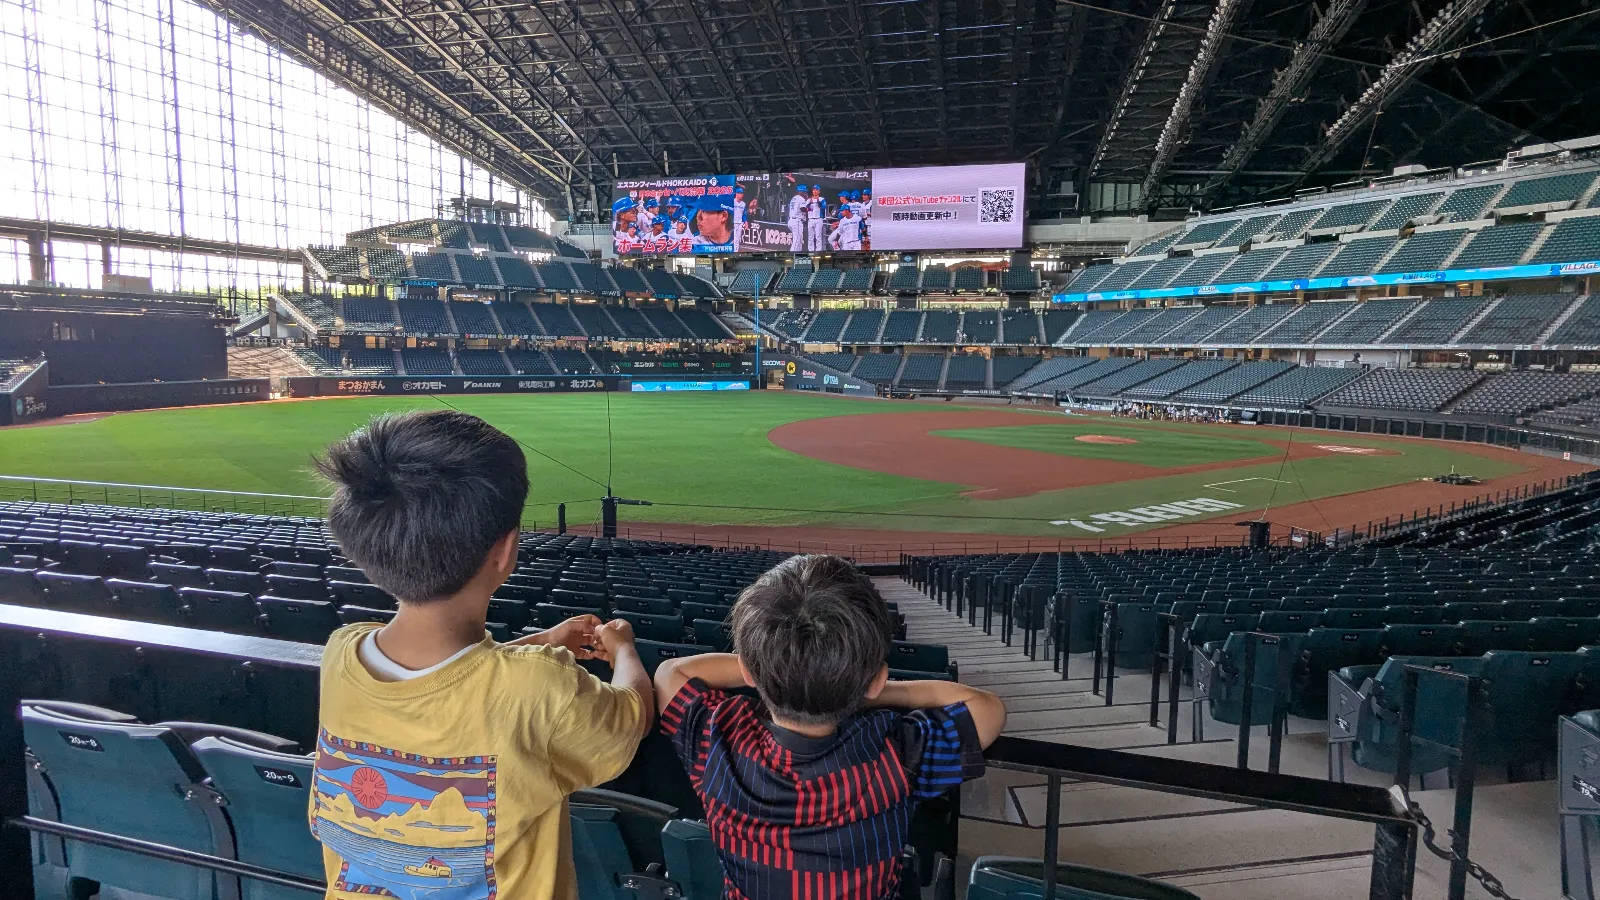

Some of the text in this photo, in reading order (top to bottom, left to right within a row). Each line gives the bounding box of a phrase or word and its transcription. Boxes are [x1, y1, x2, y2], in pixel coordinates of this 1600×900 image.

[617, 238, 693, 253] ホームラン集
[1558, 262, 1599, 271] VILLAGE
[338, 380, 386, 390] まつおかまん
[412, 381, 447, 390] オカモト
[471, 381, 502, 389] DAIKIN
[570, 379, 596, 389] 北ガス
